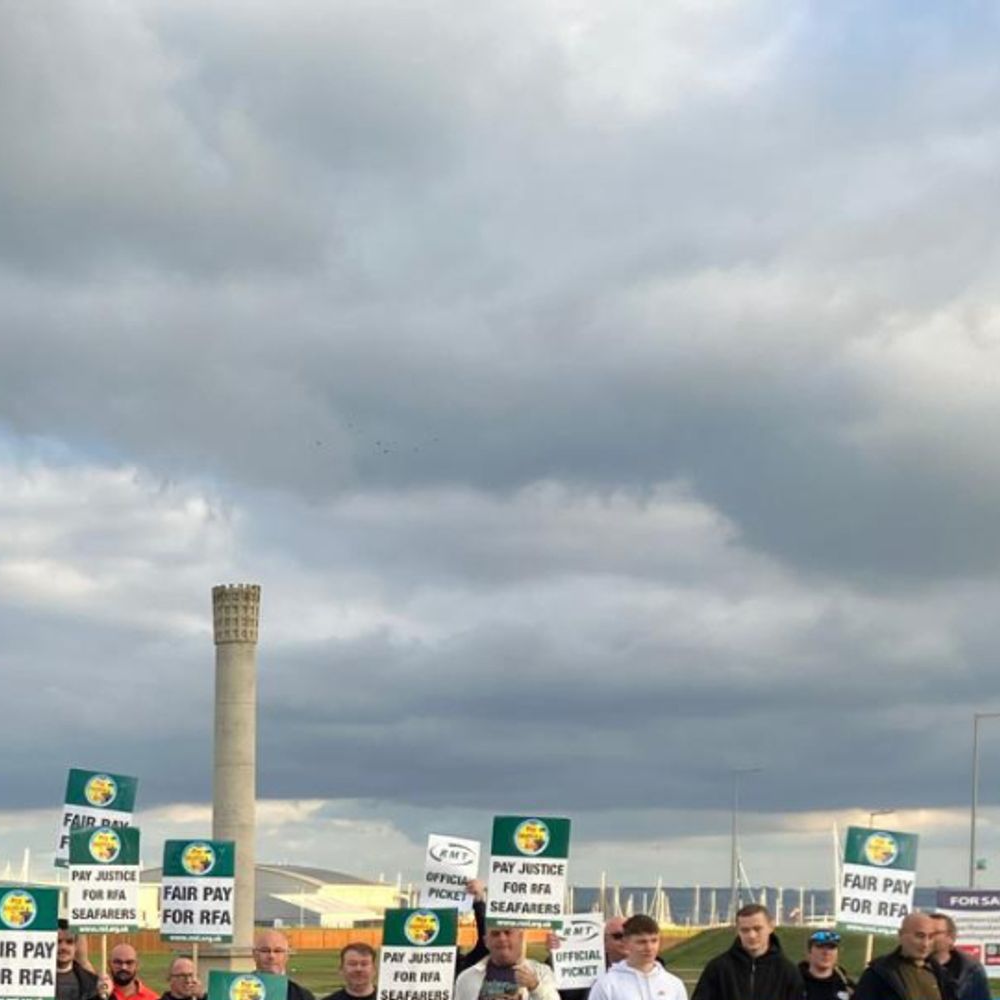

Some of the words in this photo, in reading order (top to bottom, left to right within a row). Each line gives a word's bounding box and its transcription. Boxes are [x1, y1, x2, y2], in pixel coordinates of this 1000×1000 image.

[63, 812, 96, 827] FAIR
[71, 870, 92, 881] PAY
[95, 870, 136, 881] JUSTICE
[492, 861, 516, 874] PAY
[518, 862, 565, 876] JUSTICE
[426, 871, 469, 886] OFFICIA
[843, 873, 878, 892] FAIR
[883, 878, 913, 895] PAY
[82, 889, 104, 900] FOR
[107, 889, 126, 900] RFA
[163, 885, 198, 901] FAIR
[203, 886, 233, 901] PAY
[428, 887, 466, 902] PICKET
[503, 881, 527, 894] FOR
[530, 882, 551, 895] RFA
[490, 901, 561, 915] SEAFARERS
[841, 897, 872, 915] FOR
[878, 901, 909, 917] RFA
[950, 896, 979, 907] FOR
[72, 908, 136, 920] SEAFARERS
[162, 909, 194, 924] FOR
[199, 909, 231, 925] RFA
[23, 941, 55, 959] PAY
[383, 951, 406, 963] PAY
[408, 951, 453, 963] JUSTICE
[555, 950, 602, 962] OFFICIAL
[18, 968, 53, 986] RFA
[393, 971, 417, 982] FOR
[420, 971, 441, 982] RFA
[561, 965, 598, 978] PICKET
